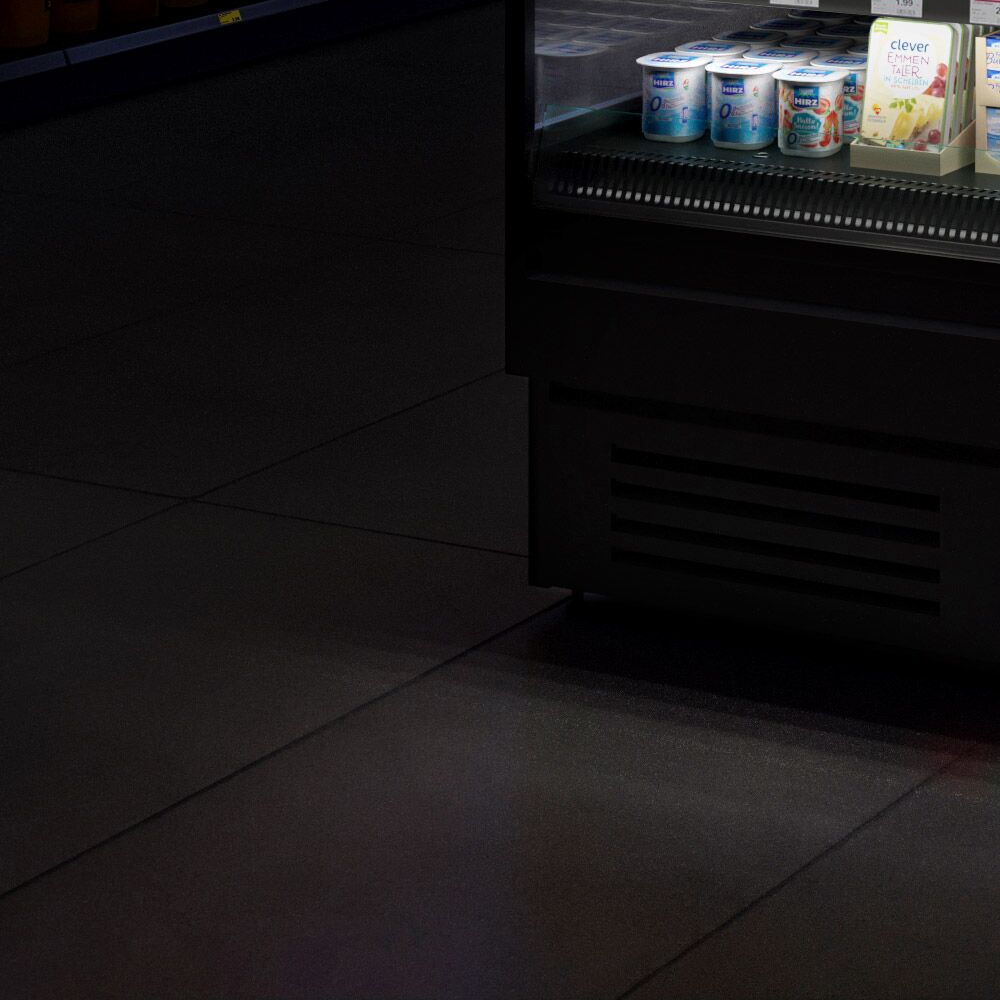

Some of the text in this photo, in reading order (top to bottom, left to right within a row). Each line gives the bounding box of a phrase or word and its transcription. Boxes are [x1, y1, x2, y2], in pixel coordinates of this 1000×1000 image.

[890, 40, 929, 52] clever
[888, 53, 930, 65] EMMEN
[892, 65, 922, 79] TALER
[722, 86, 744, 94] HIRZ
[795, 97, 818, 106] HIRZ
